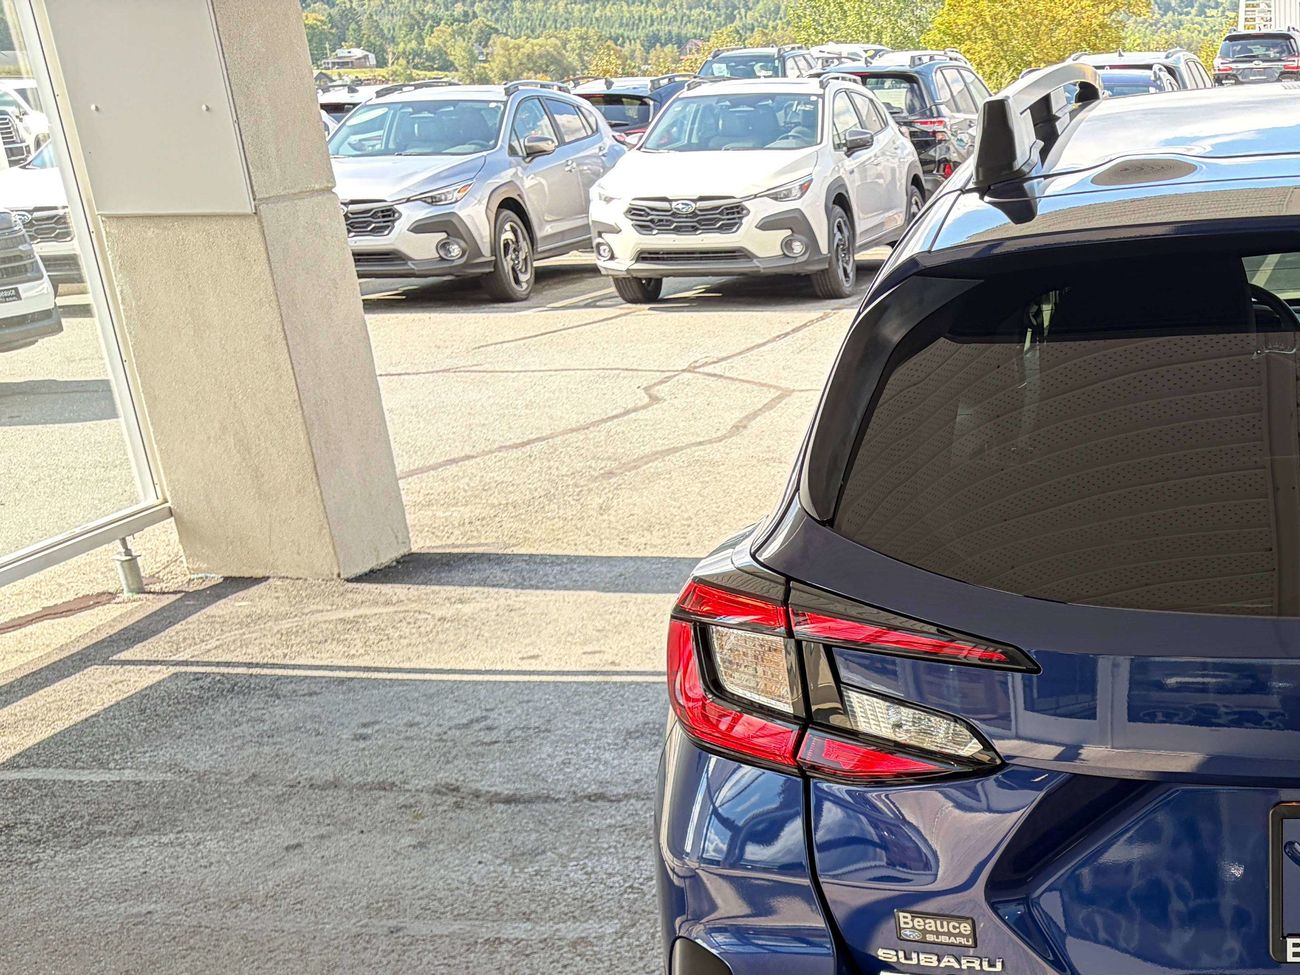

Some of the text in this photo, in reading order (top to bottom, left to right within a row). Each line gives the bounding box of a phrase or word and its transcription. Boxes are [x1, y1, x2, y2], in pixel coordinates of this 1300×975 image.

[899, 912, 972, 935] Beauce
[926, 934, 972, 945] SUBARU
[877, 948, 1003, 972] SUBARU
